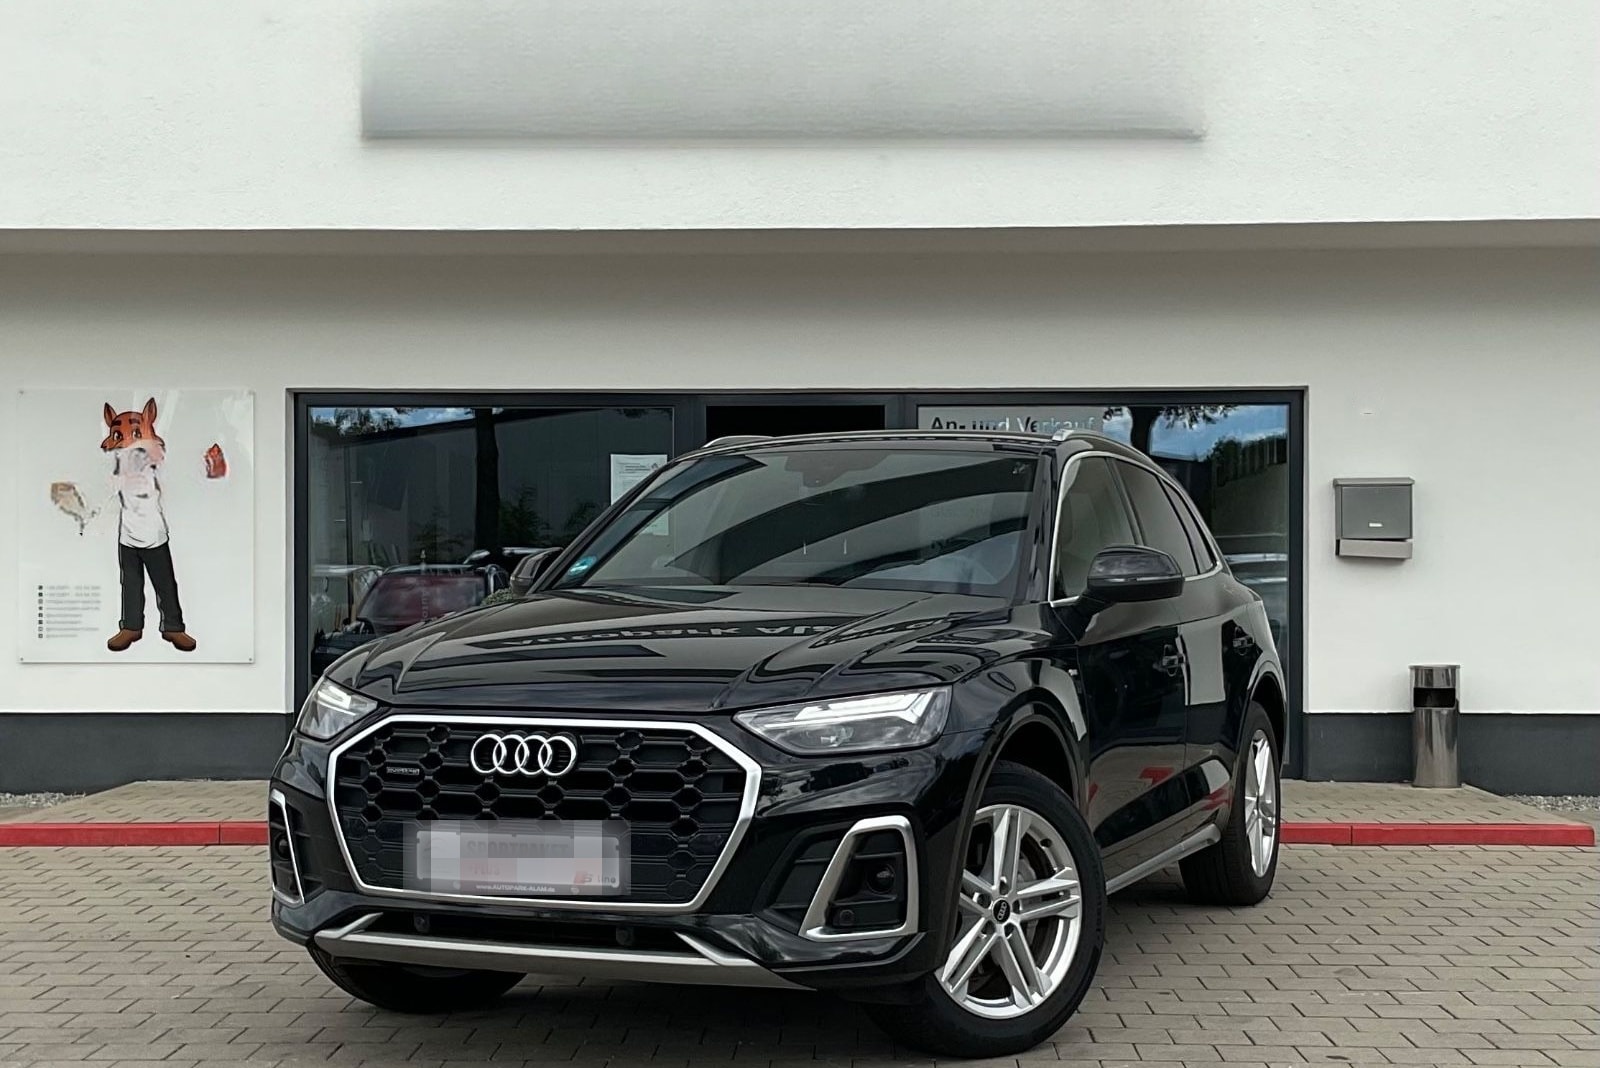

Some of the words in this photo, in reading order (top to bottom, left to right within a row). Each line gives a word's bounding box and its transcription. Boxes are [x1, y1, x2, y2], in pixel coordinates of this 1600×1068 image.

[931, 417, 966, 431] An-
[972, 418, 1010, 431] und
[1017, 417, 1094, 433] Verkauf
